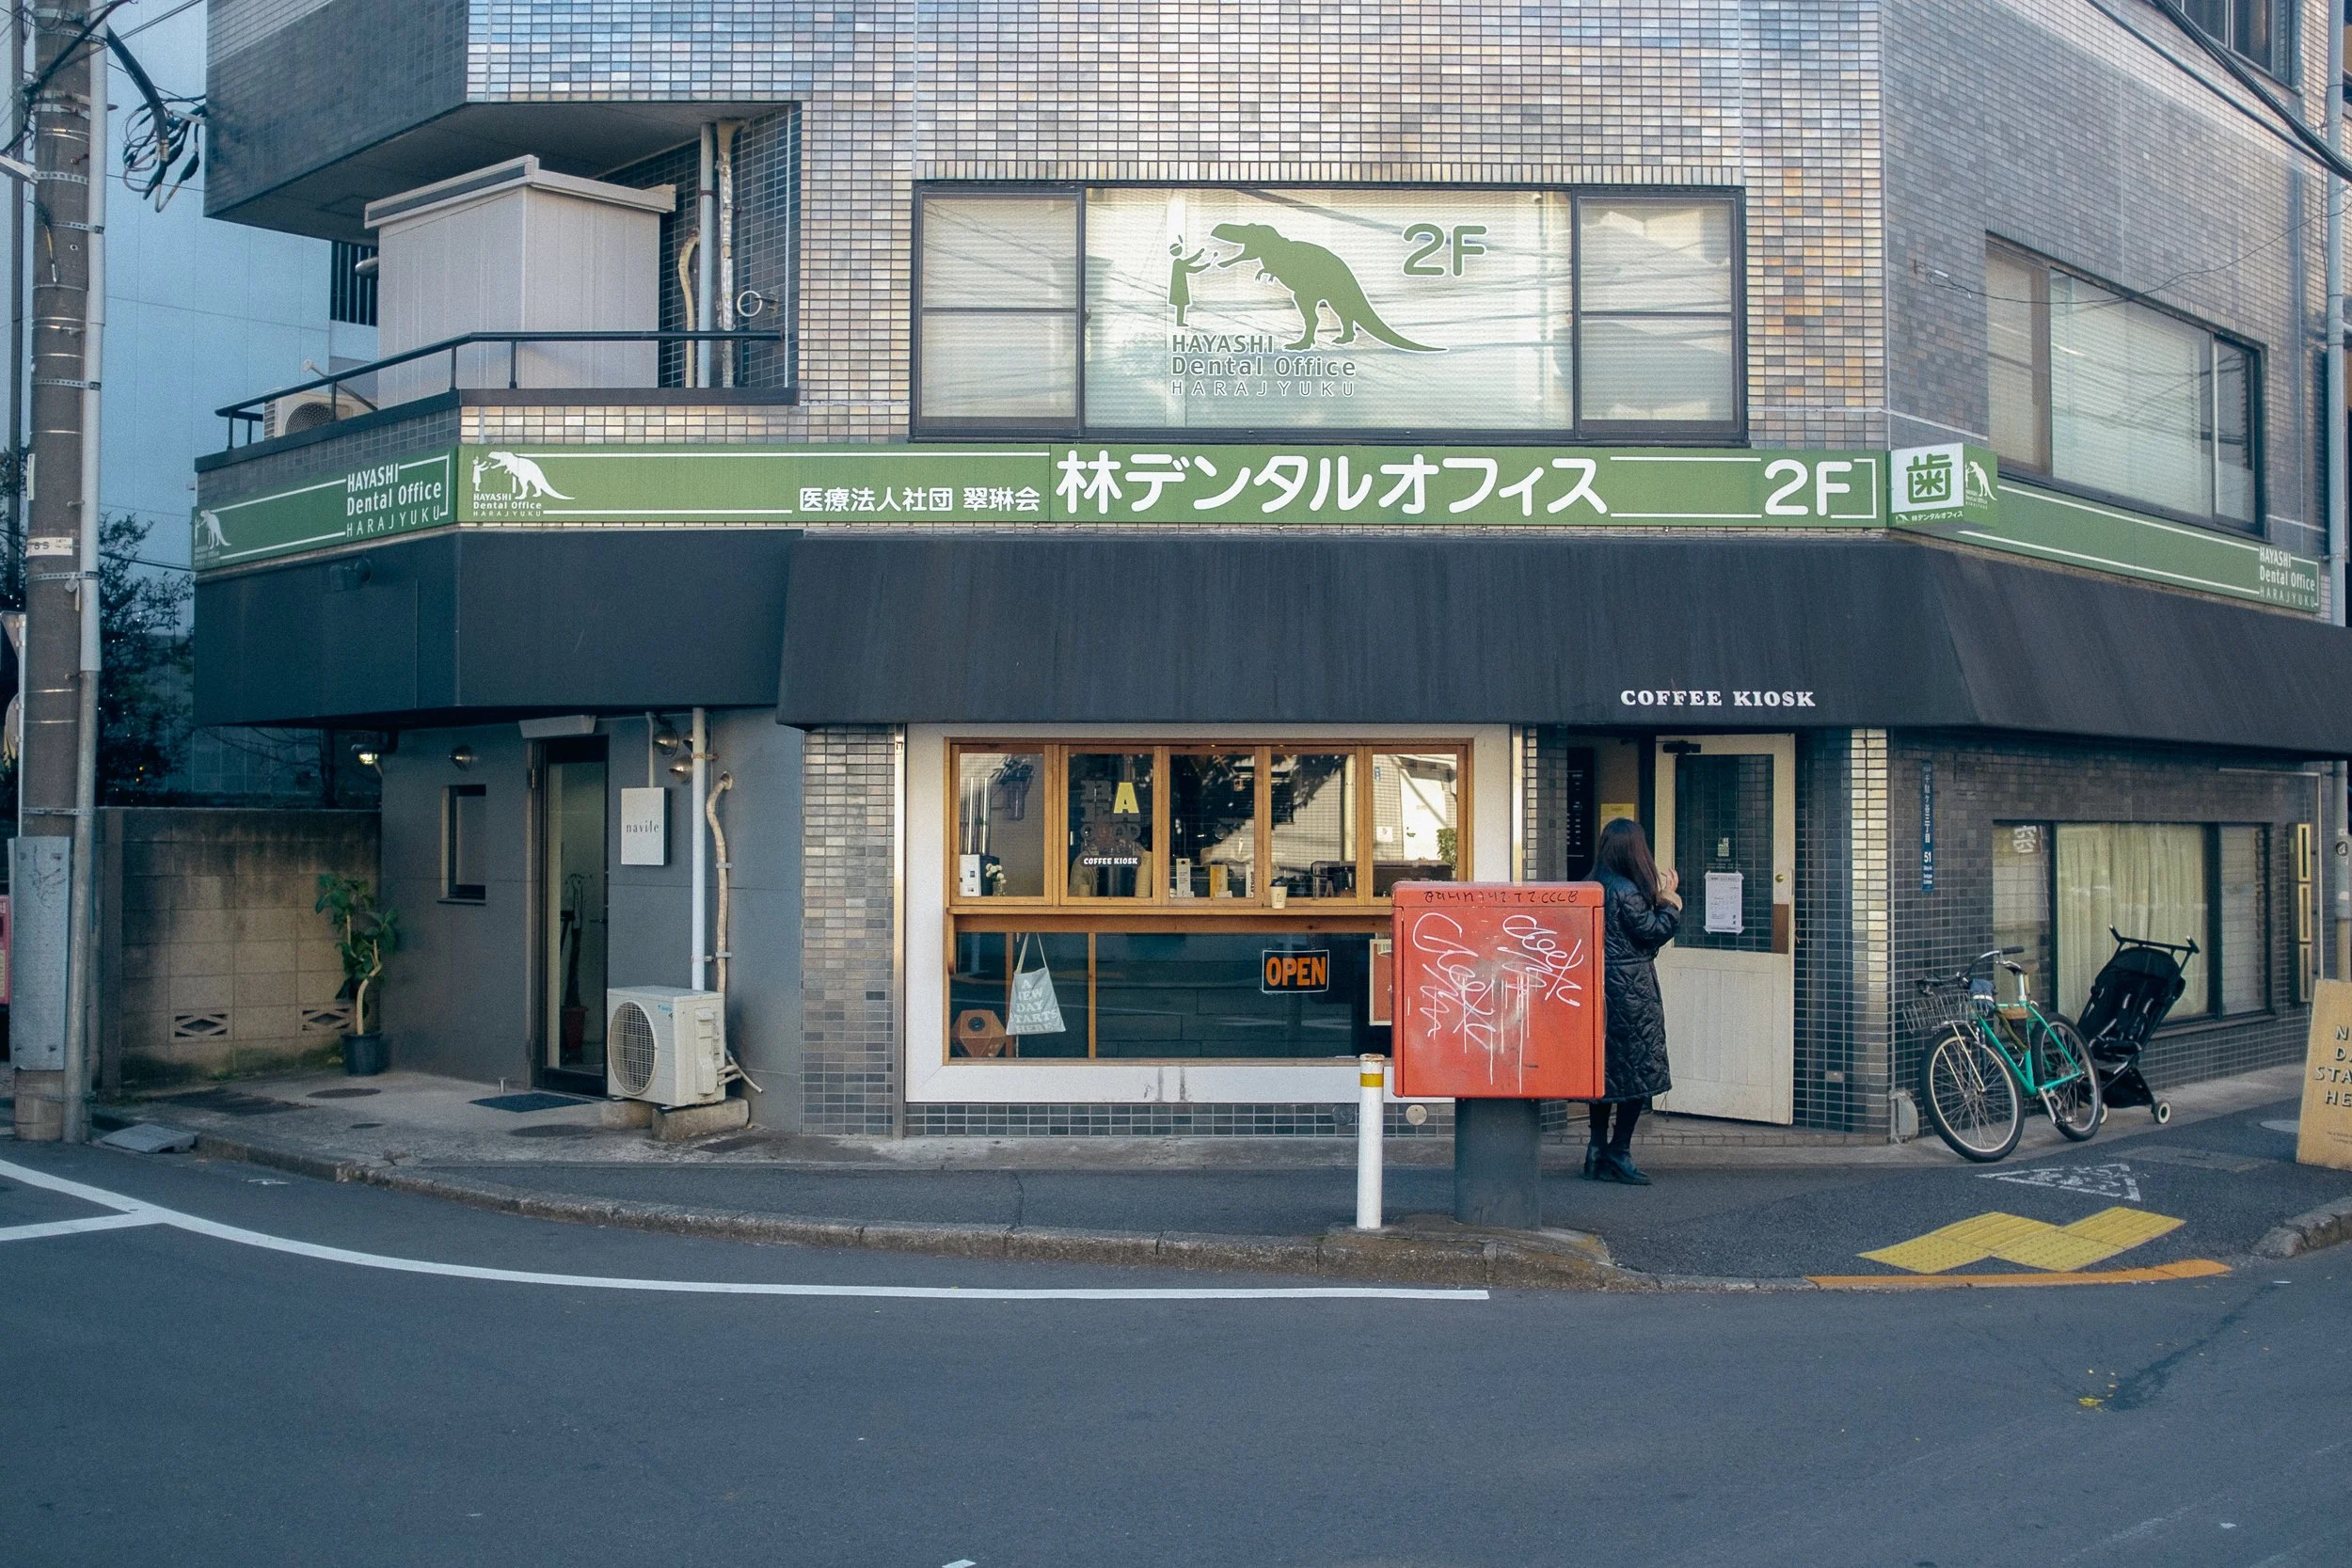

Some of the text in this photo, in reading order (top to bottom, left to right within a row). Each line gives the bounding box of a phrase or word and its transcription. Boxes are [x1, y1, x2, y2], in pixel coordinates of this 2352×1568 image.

[1404, 223, 1487, 277] 2F
[1172, 334, 1273, 353] HAYASHI
[1172, 356, 1356, 376] Dental Office
[1171, 381, 1354, 396] HARAJYUKU
[347, 463, 399, 493] HAYASHI
[1056, 450, 1608, 516] 林デンタルオフィス
[1764, 458, 1852, 516] 2F
[1906, 453, 1953, 504] 歯
[346, 481, 441, 516] Dental Office
[473, 493, 512, 501] HAYASHI
[473, 500, 542, 510] Dental Office
[799, 486, 1041, 513] 医療法人社団 翠琳会
[346, 505, 440, 537] HARAJYUKU
[2260, 546, 2291, 568] HAYASHI
[2260, 565, 2315, 592] Dental Office
[1620, 689, 1816, 706] COFFEE KIOSK
[626, 820, 660, 833] navile
[1083, 857, 1112, 865] COFFEE
[1923, 850, 1931, 863] 51
[1265, 956, 1327, 987] OPEN
[1016, 999, 1043, 1012] DAY
